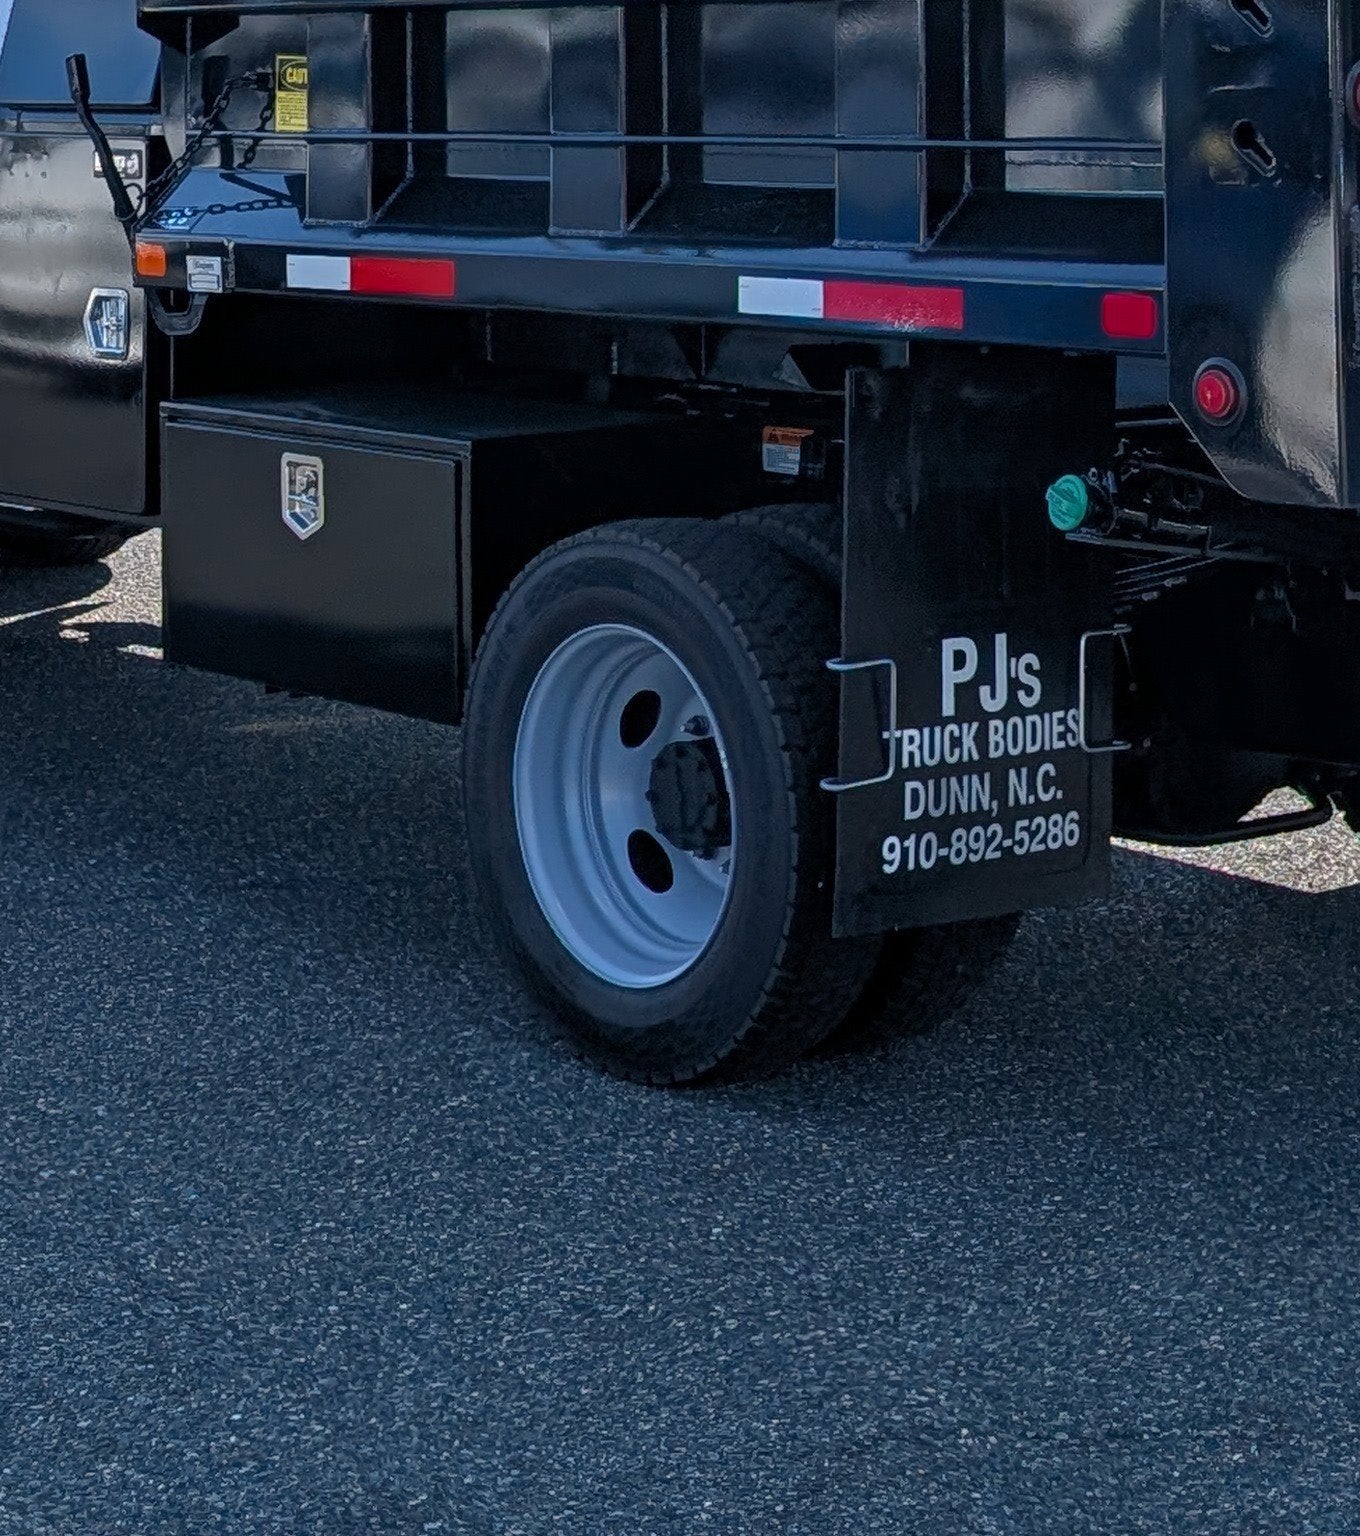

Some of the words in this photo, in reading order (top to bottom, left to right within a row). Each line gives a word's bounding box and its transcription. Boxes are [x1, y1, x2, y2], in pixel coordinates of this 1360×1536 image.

[941, 632, 1042, 717] PJ's
[988, 708, 1080, 759] BODIES
[904, 771, 999, 821] DUNN,
[1007, 762, 1064, 807] N.C.
[881, 810, 1080, 874] 910-892-5286
